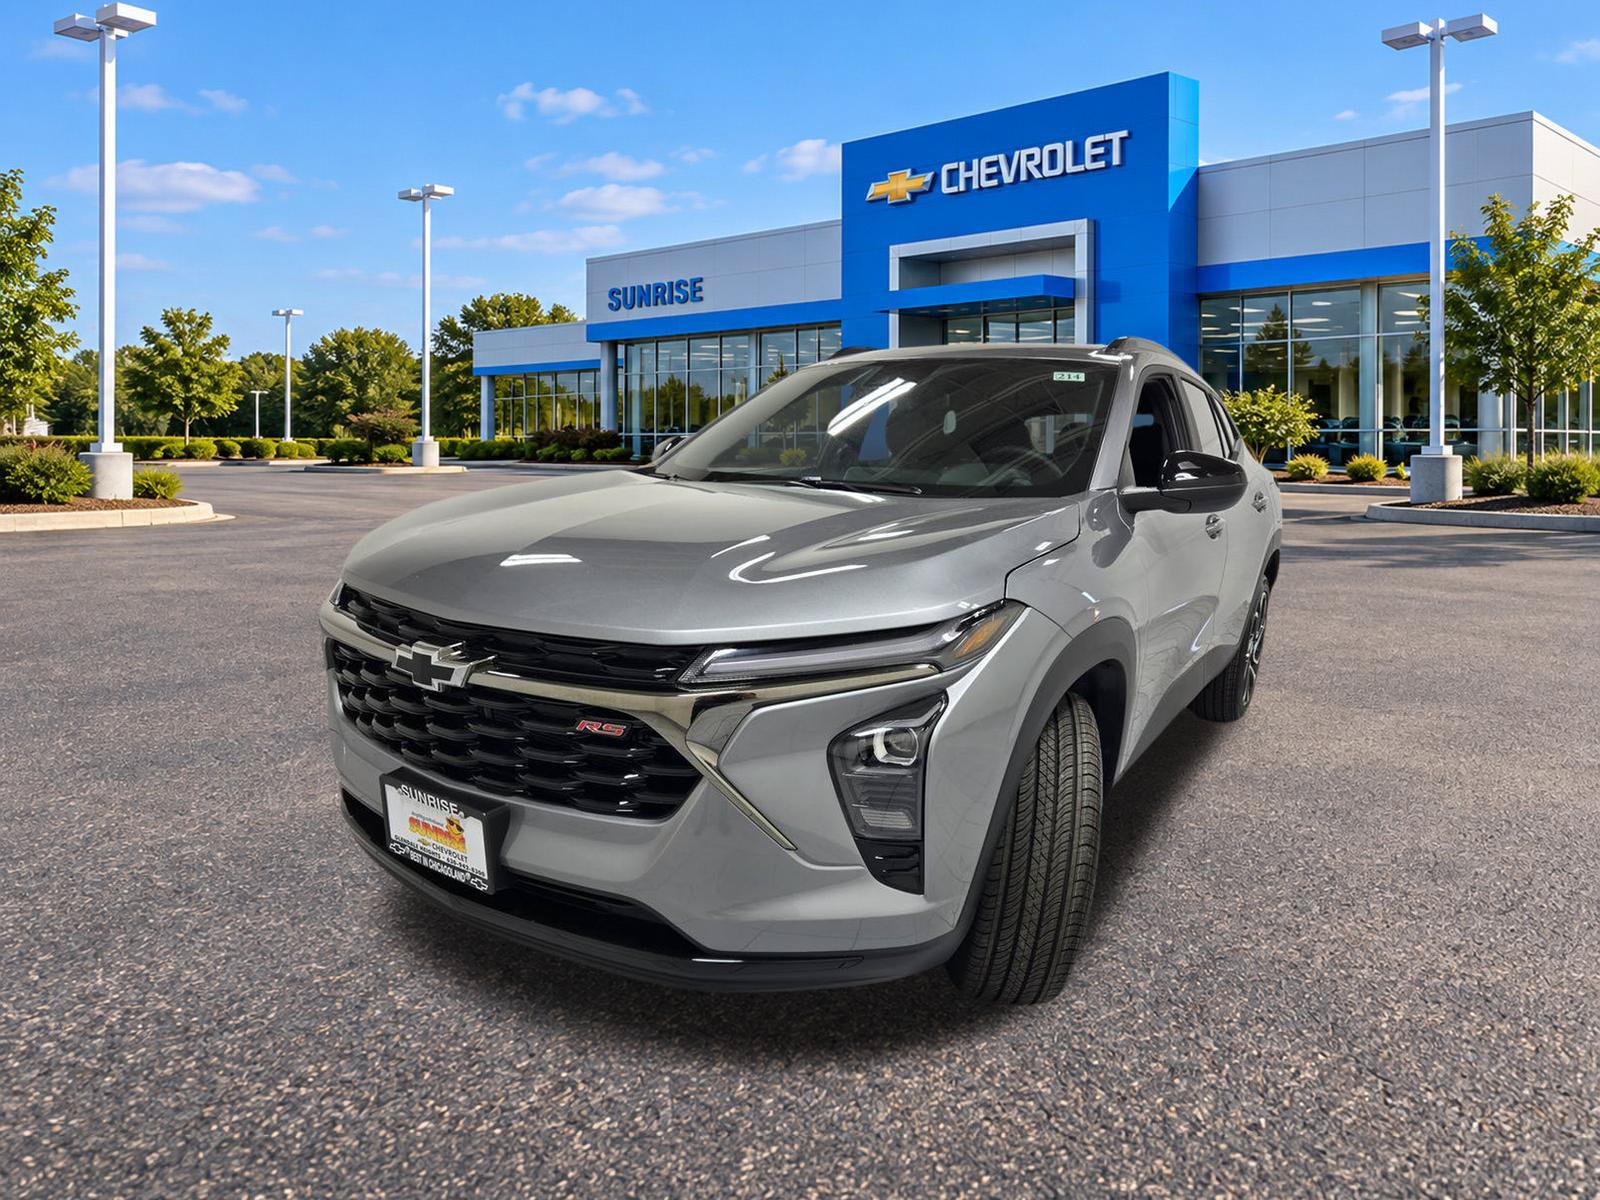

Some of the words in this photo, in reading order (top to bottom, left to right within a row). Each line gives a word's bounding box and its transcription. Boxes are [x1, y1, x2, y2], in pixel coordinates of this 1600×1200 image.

[941, 130, 1129, 194] CHEVROLET
[608, 277, 704, 312] SUNRISE
[576, 720, 627, 737] RS
[401, 784, 458, 816] SUNRISE
[410, 850, 422, 864] BEST
[422, 856, 429, 867] IN
[429, 859, 465, 883] CHICAGOLAND
[432, 843, 468, 863] CHEVROLET
